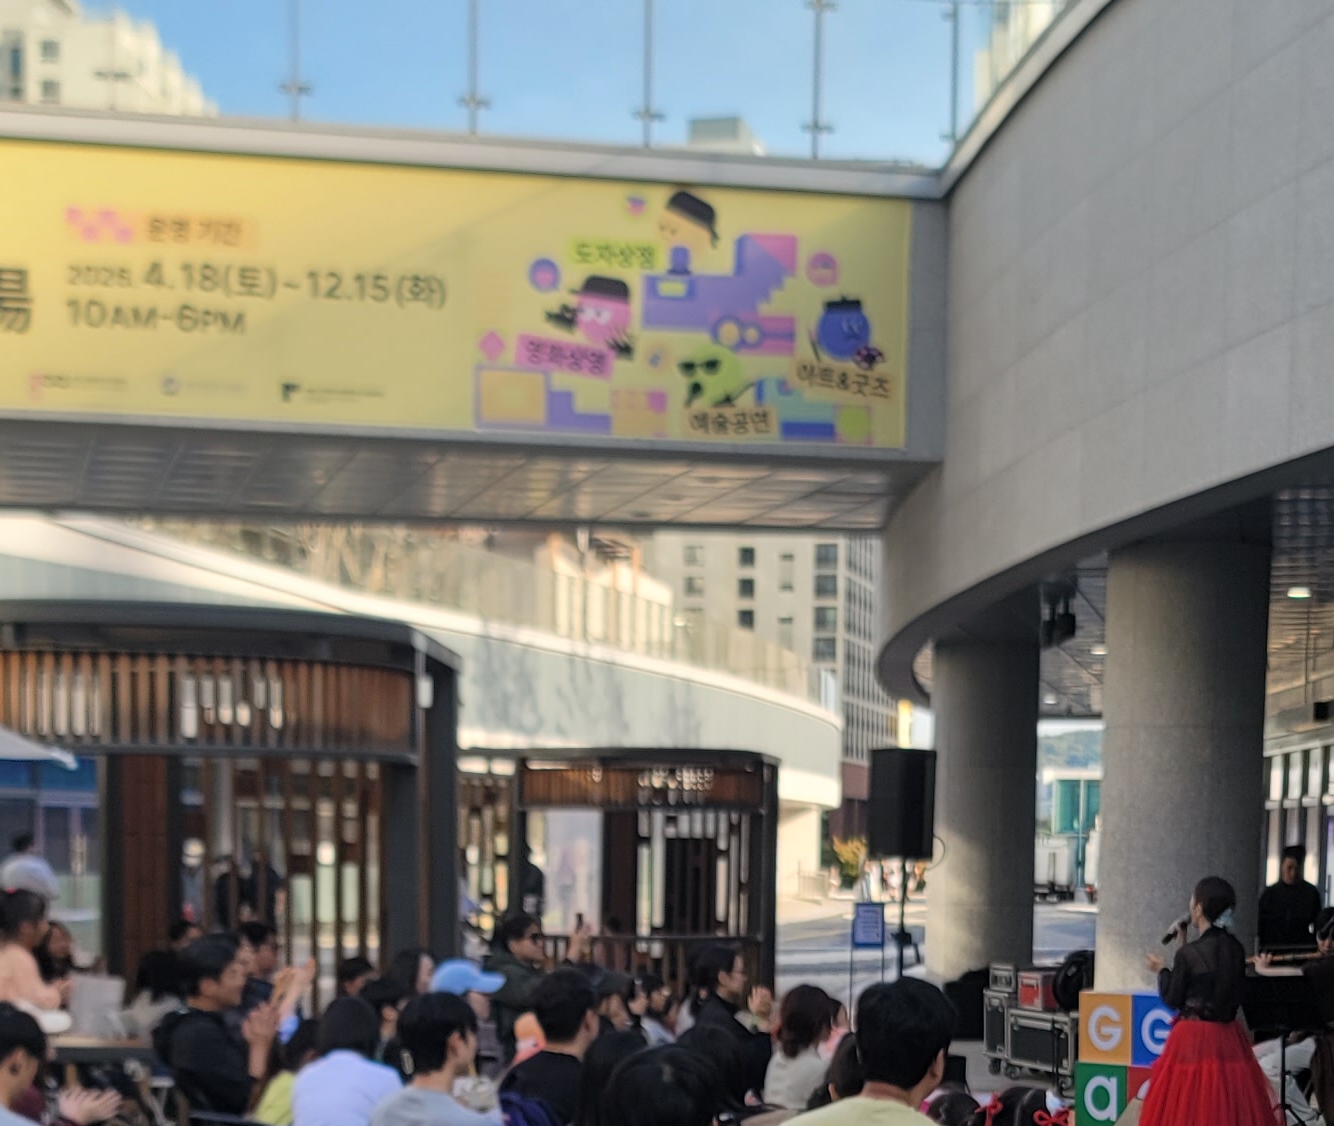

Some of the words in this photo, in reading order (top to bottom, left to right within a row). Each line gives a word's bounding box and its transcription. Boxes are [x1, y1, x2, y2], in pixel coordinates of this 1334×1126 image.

[576, 243, 655, 269] 도자상점
[527, 340, 607, 375] 영화상영
[796, 363, 891, 398] 아트&굿즈
[689, 410, 771, 434] 예술공연
